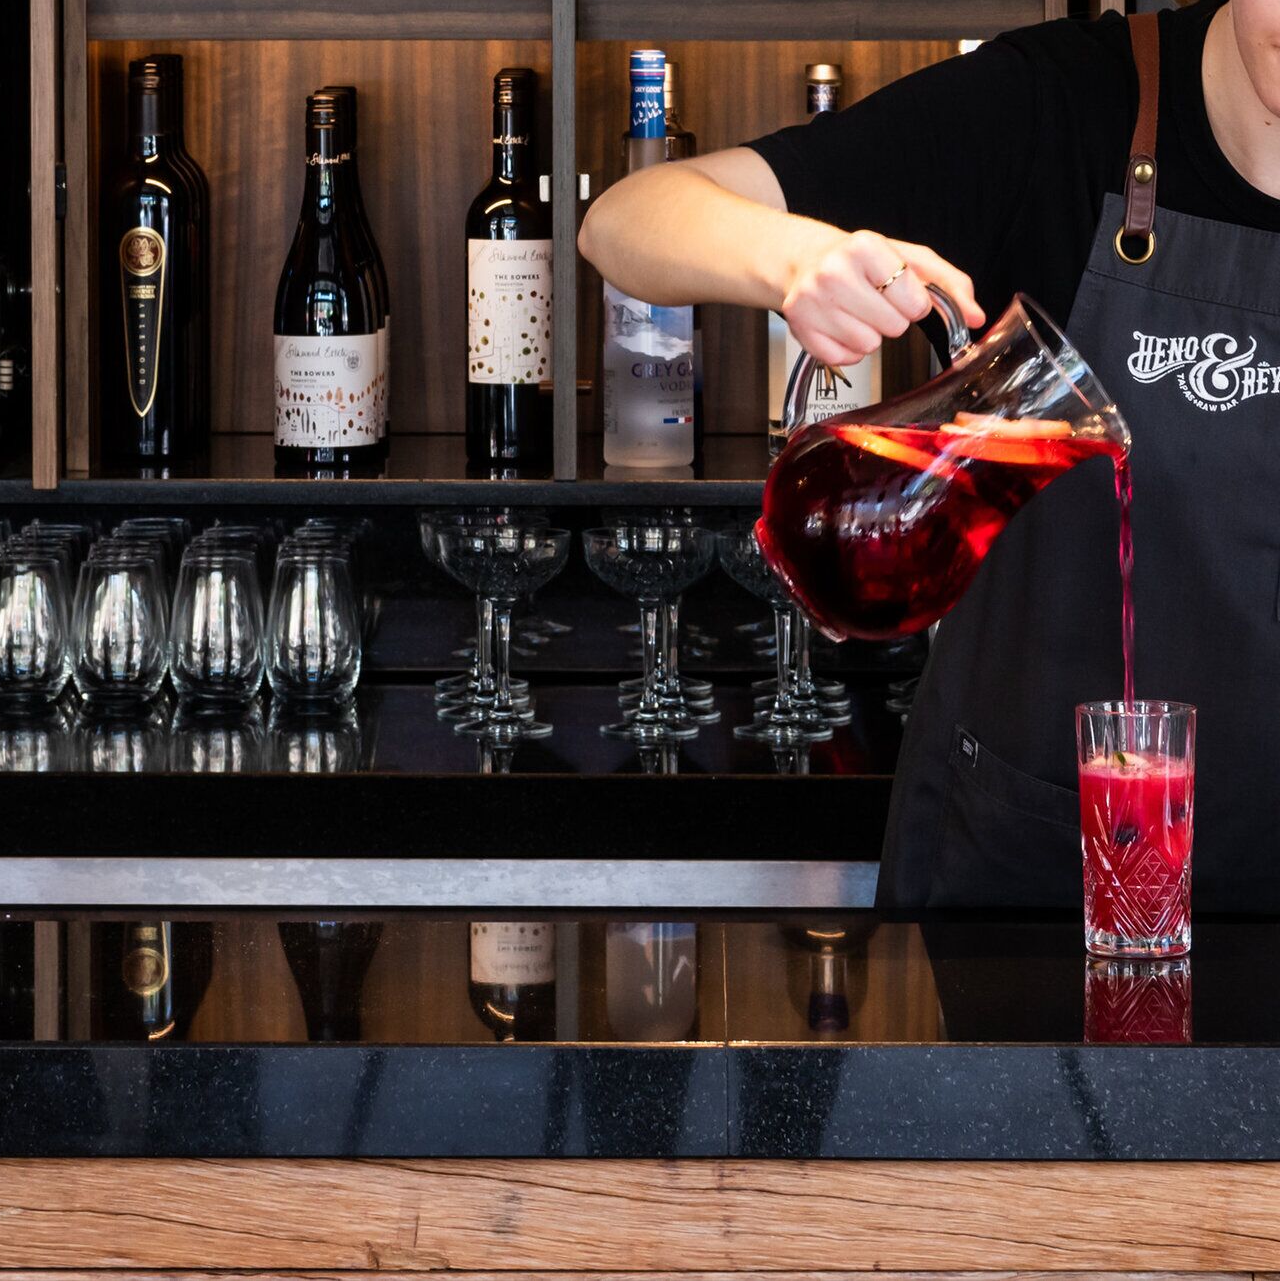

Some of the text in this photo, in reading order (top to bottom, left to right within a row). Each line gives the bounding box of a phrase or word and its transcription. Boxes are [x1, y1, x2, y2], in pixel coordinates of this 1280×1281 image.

[631, 362, 673, 379] GREY
[1128, 331, 1199, 379] HENO
[1189, 332, 1257, 402] &
[1176, 373, 1239, 412] TAPAS RAW BAR
